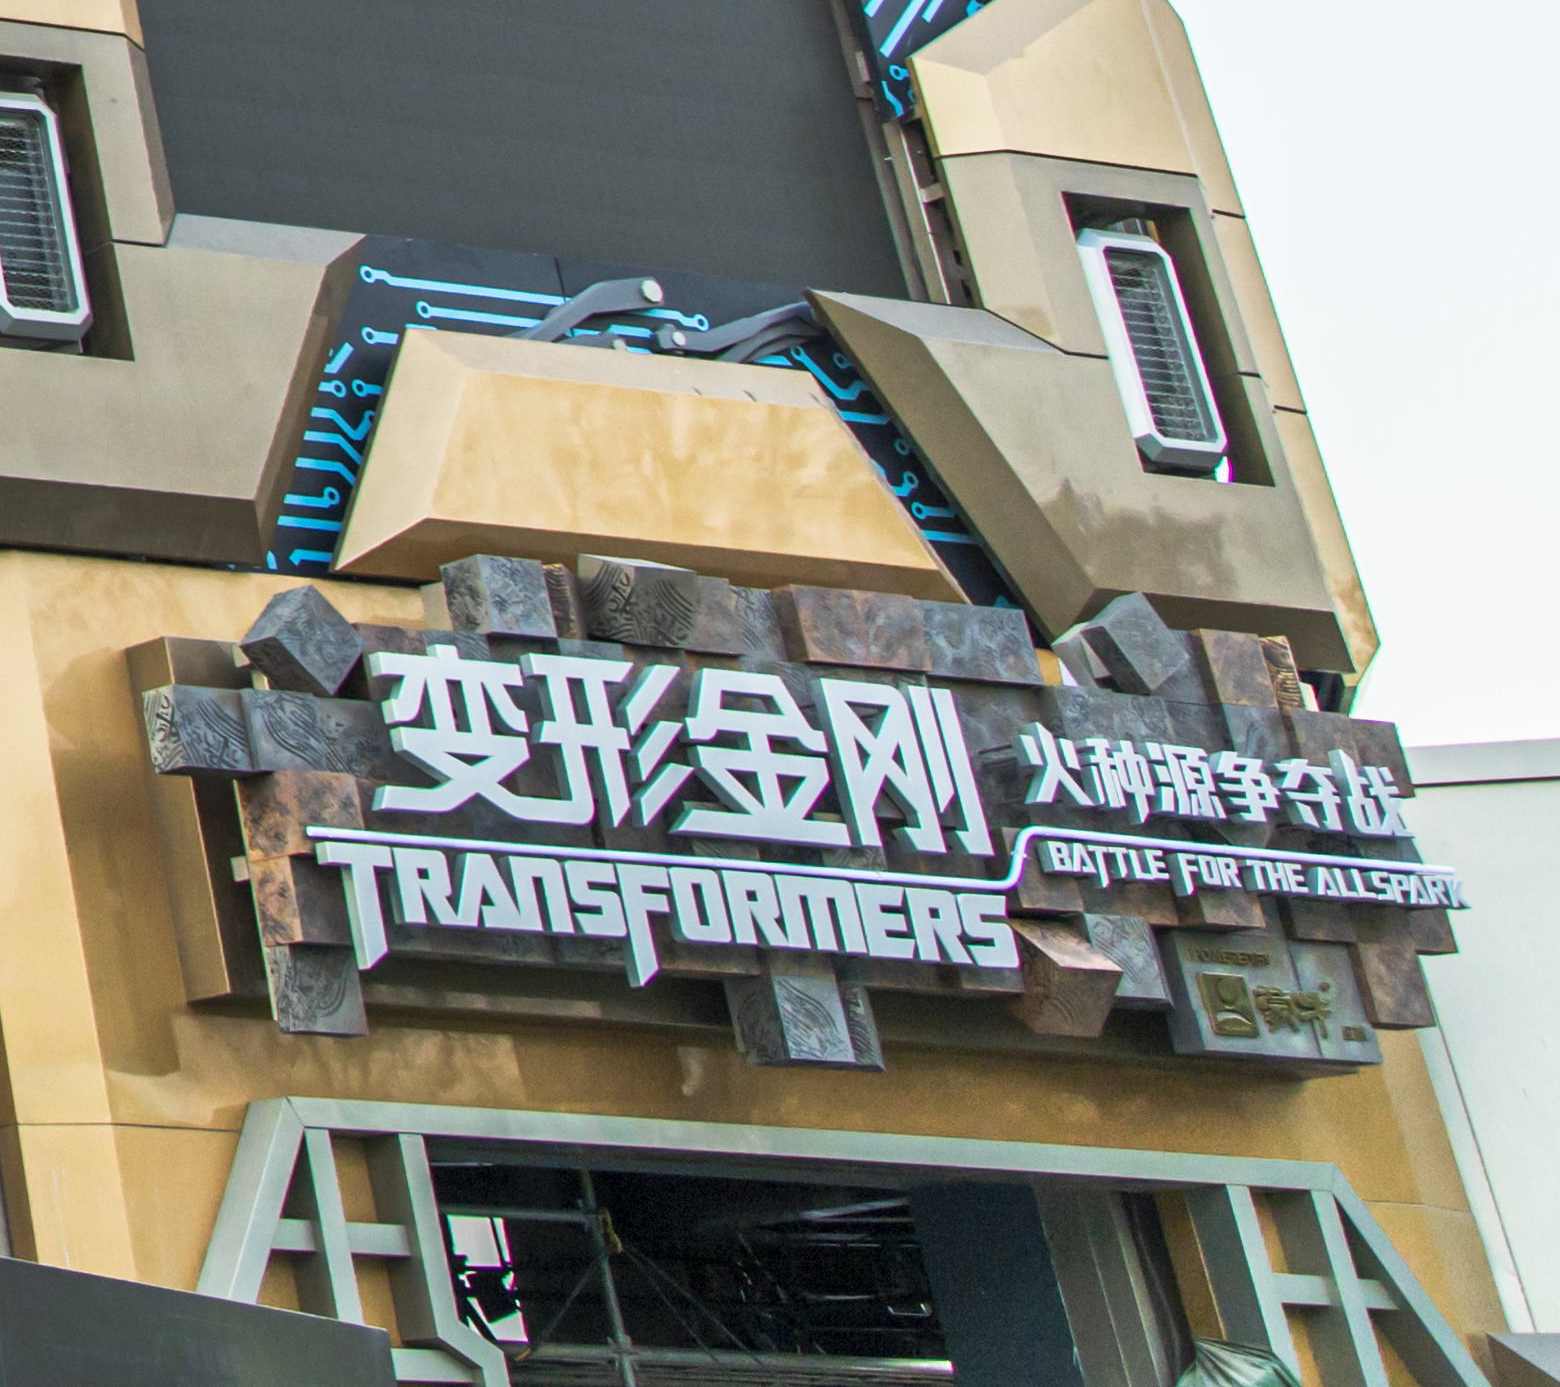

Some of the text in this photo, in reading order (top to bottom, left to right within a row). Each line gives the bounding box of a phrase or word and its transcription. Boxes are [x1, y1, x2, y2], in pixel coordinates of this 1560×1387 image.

[368, 645, 994, 856] 变形金刚
[1020, 722, 1414, 838] 火种源争夺战
[316, 842, 1020, 987] TRANSFORMERS
[1039, 840, 1472, 909] BATTLE FOR THE ALLSPARK
